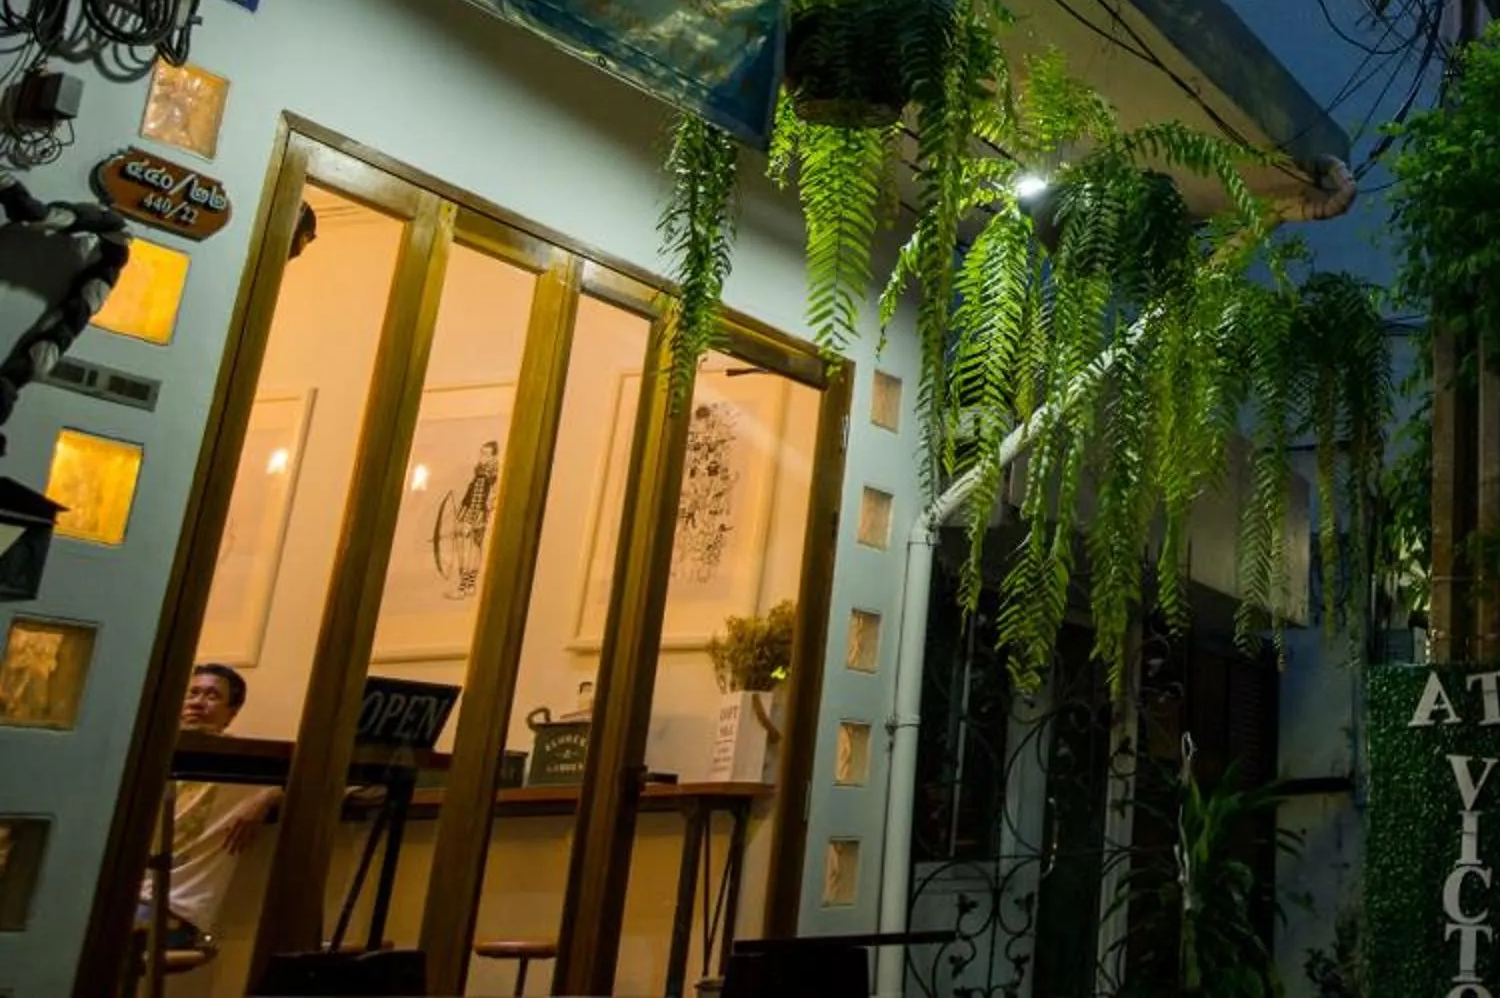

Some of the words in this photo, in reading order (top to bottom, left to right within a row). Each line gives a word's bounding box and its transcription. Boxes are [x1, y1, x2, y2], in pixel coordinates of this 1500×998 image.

[143, 192, 198, 224] 440/22
[357, 689, 449, 741] OPEN
[1442, 754, 1500, 998] VICT
